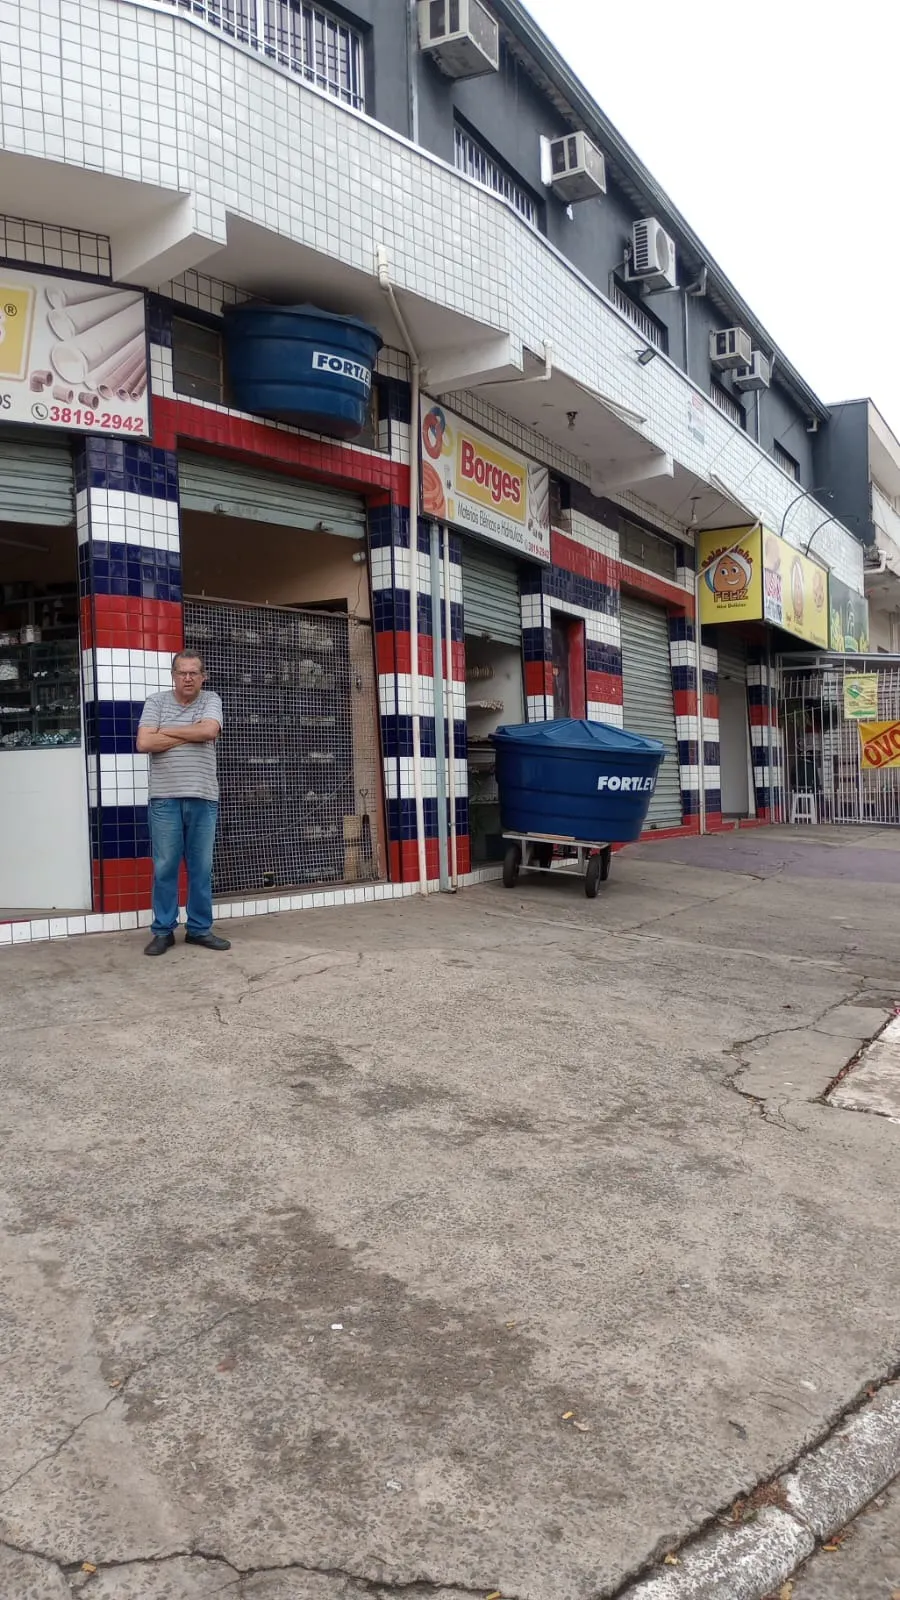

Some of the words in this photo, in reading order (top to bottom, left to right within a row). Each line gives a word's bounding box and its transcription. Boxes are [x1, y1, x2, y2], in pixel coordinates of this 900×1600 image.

[49, 406, 144, 432] 3819-2942
[461, 439, 521, 503] Borges
[713, 588, 749, 603] FELIZ
